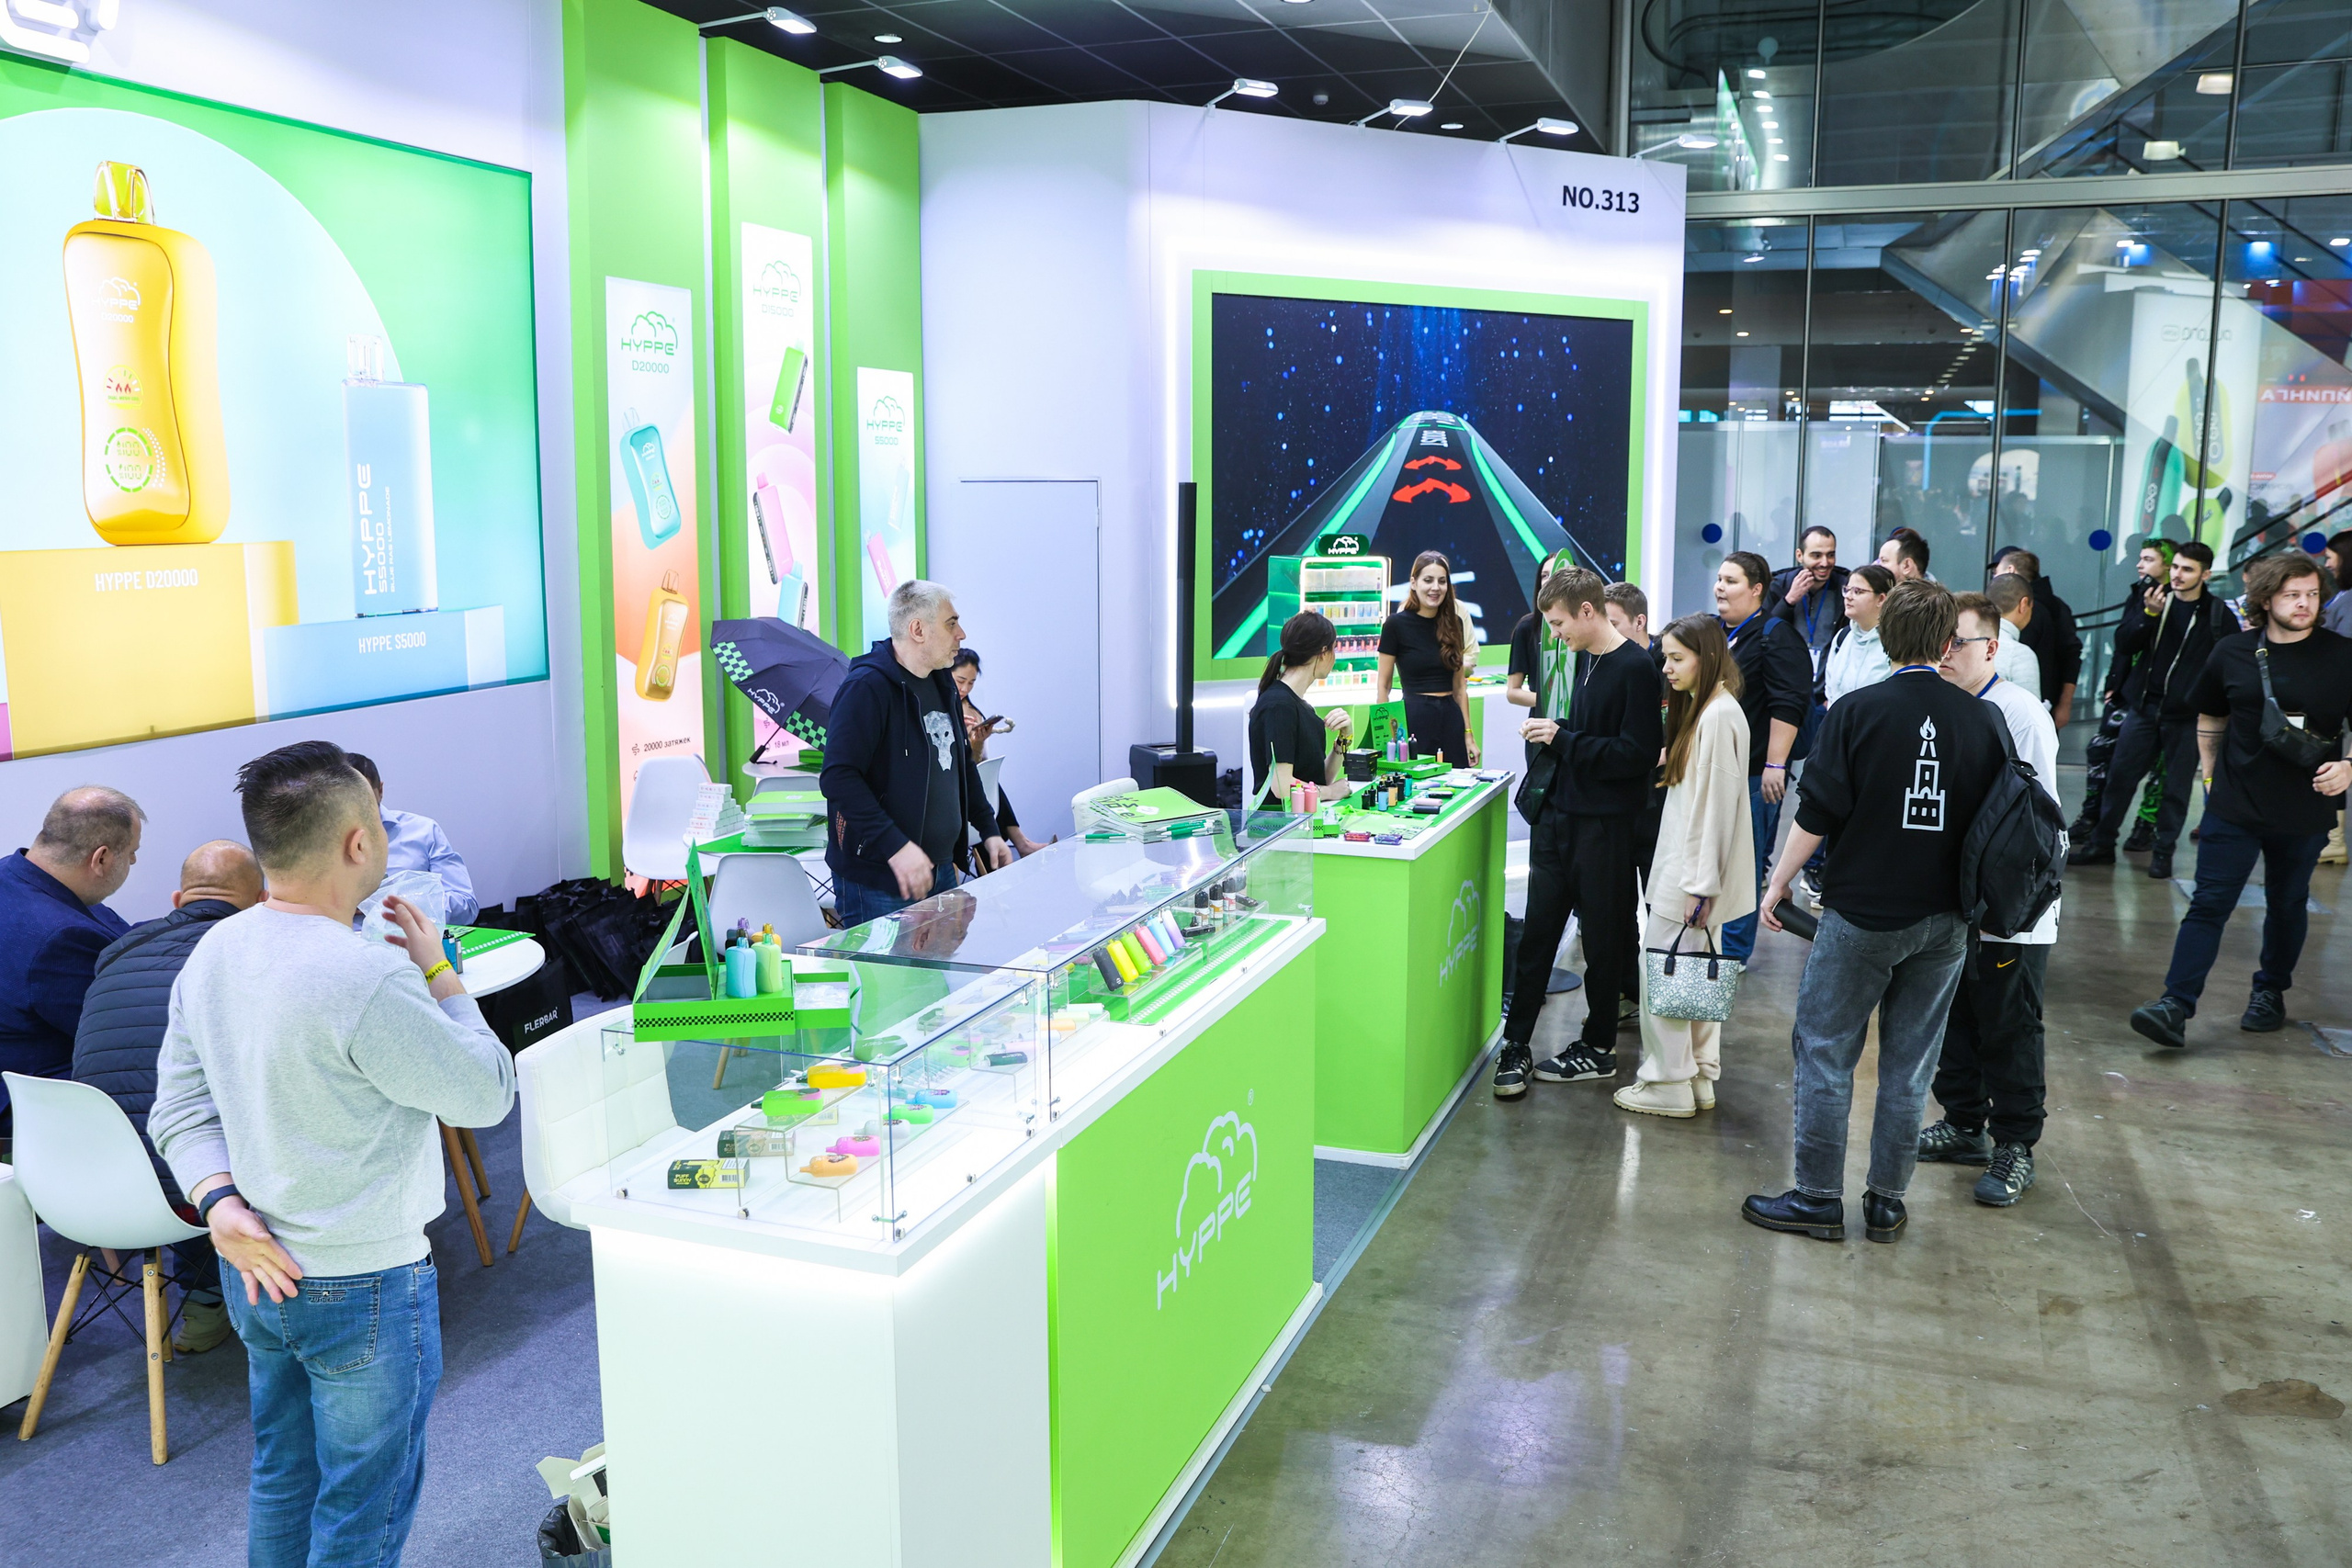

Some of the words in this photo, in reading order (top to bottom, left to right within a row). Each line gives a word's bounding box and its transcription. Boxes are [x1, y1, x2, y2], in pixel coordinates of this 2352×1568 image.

[1562, 185, 1640, 213] NO.313
[90, 296, 139, 311] HYPPE
[752, 284, 798, 303] HYPPE
[101, 311, 135, 323] D20000
[761, 303, 794, 318] D15000
[621, 337, 674, 356] HYPPE
[632, 360, 670, 374] D20000
[866, 419, 903, 433] HYPPE
[356, 463, 378, 595] HYPPE
[375, 522, 388, 593] S5000
[94, 571, 143, 592] HYPPE
[145, 568, 199, 589] D20000
[358, 635, 392, 654] HYPPE
[394, 630, 426, 650] S5000
[747, 688, 775, 715] HYPPE
[644, 740, 663, 752] 20000
[663, 737, 692, 749] затяжек
[1439, 924, 1477, 988] HYPPE
[524, 1009, 559, 1034] FLERBAR
[1157, 1170, 1251, 1311] HYPPE
